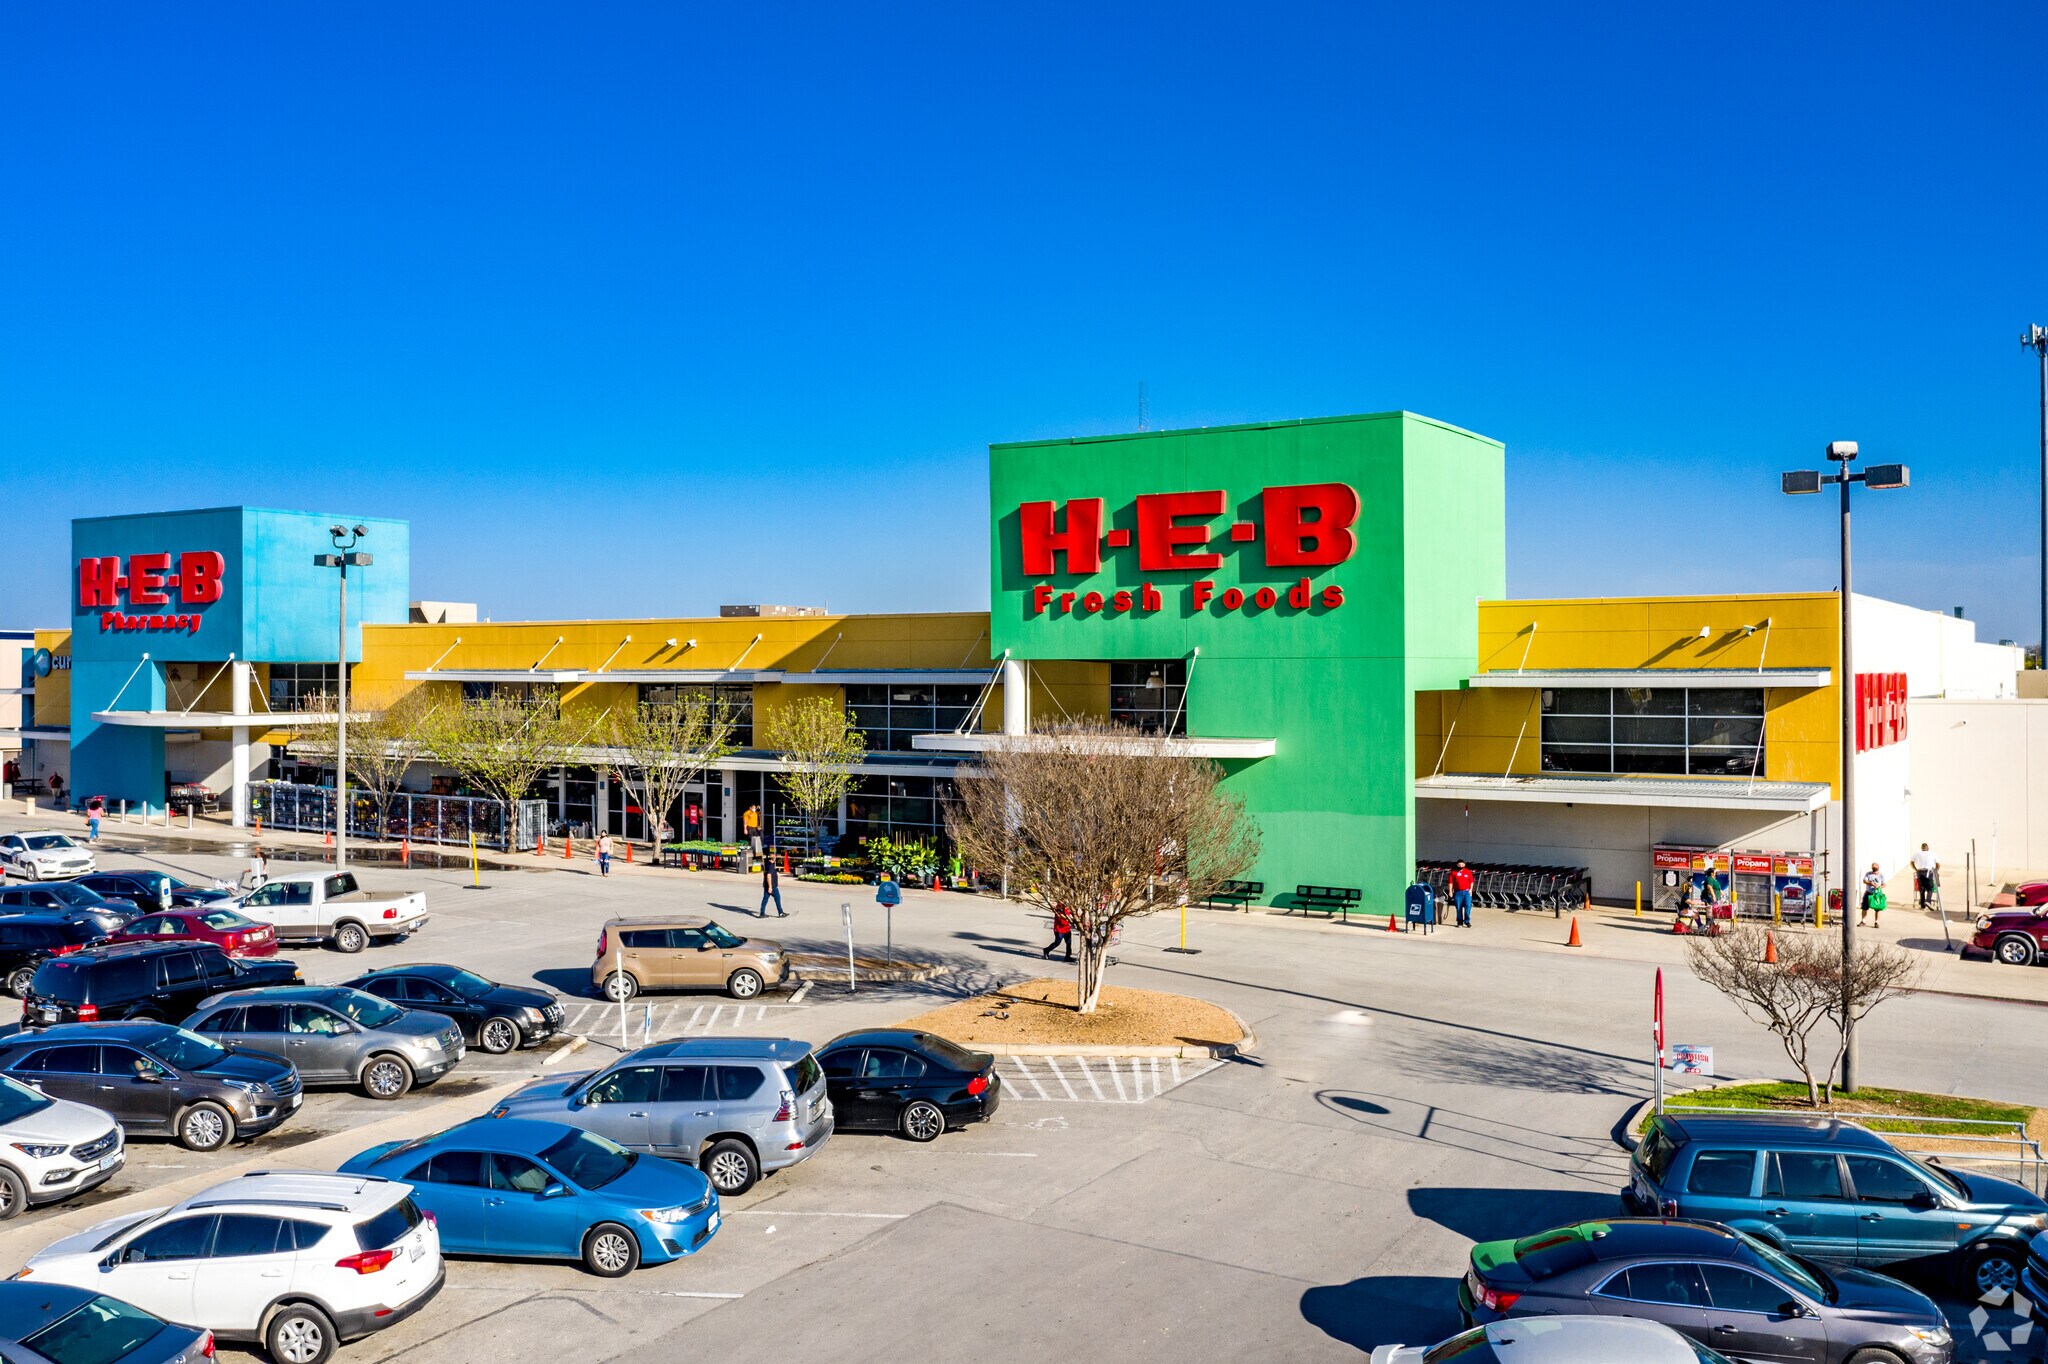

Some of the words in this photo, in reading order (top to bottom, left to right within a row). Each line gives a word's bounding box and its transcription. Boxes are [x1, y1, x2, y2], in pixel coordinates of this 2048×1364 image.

[1020, 482, 1360, 577] H-E-B
[79, 551, 225, 607] H-E-B
[1033, 582, 1163, 614] Fresh
[1193, 577, 1345, 612] Foods
[101, 611, 202, 633] Pharmacy
[1656, 854, 1688, 863] Propane
[1737, 858, 1769, 868] Propane
